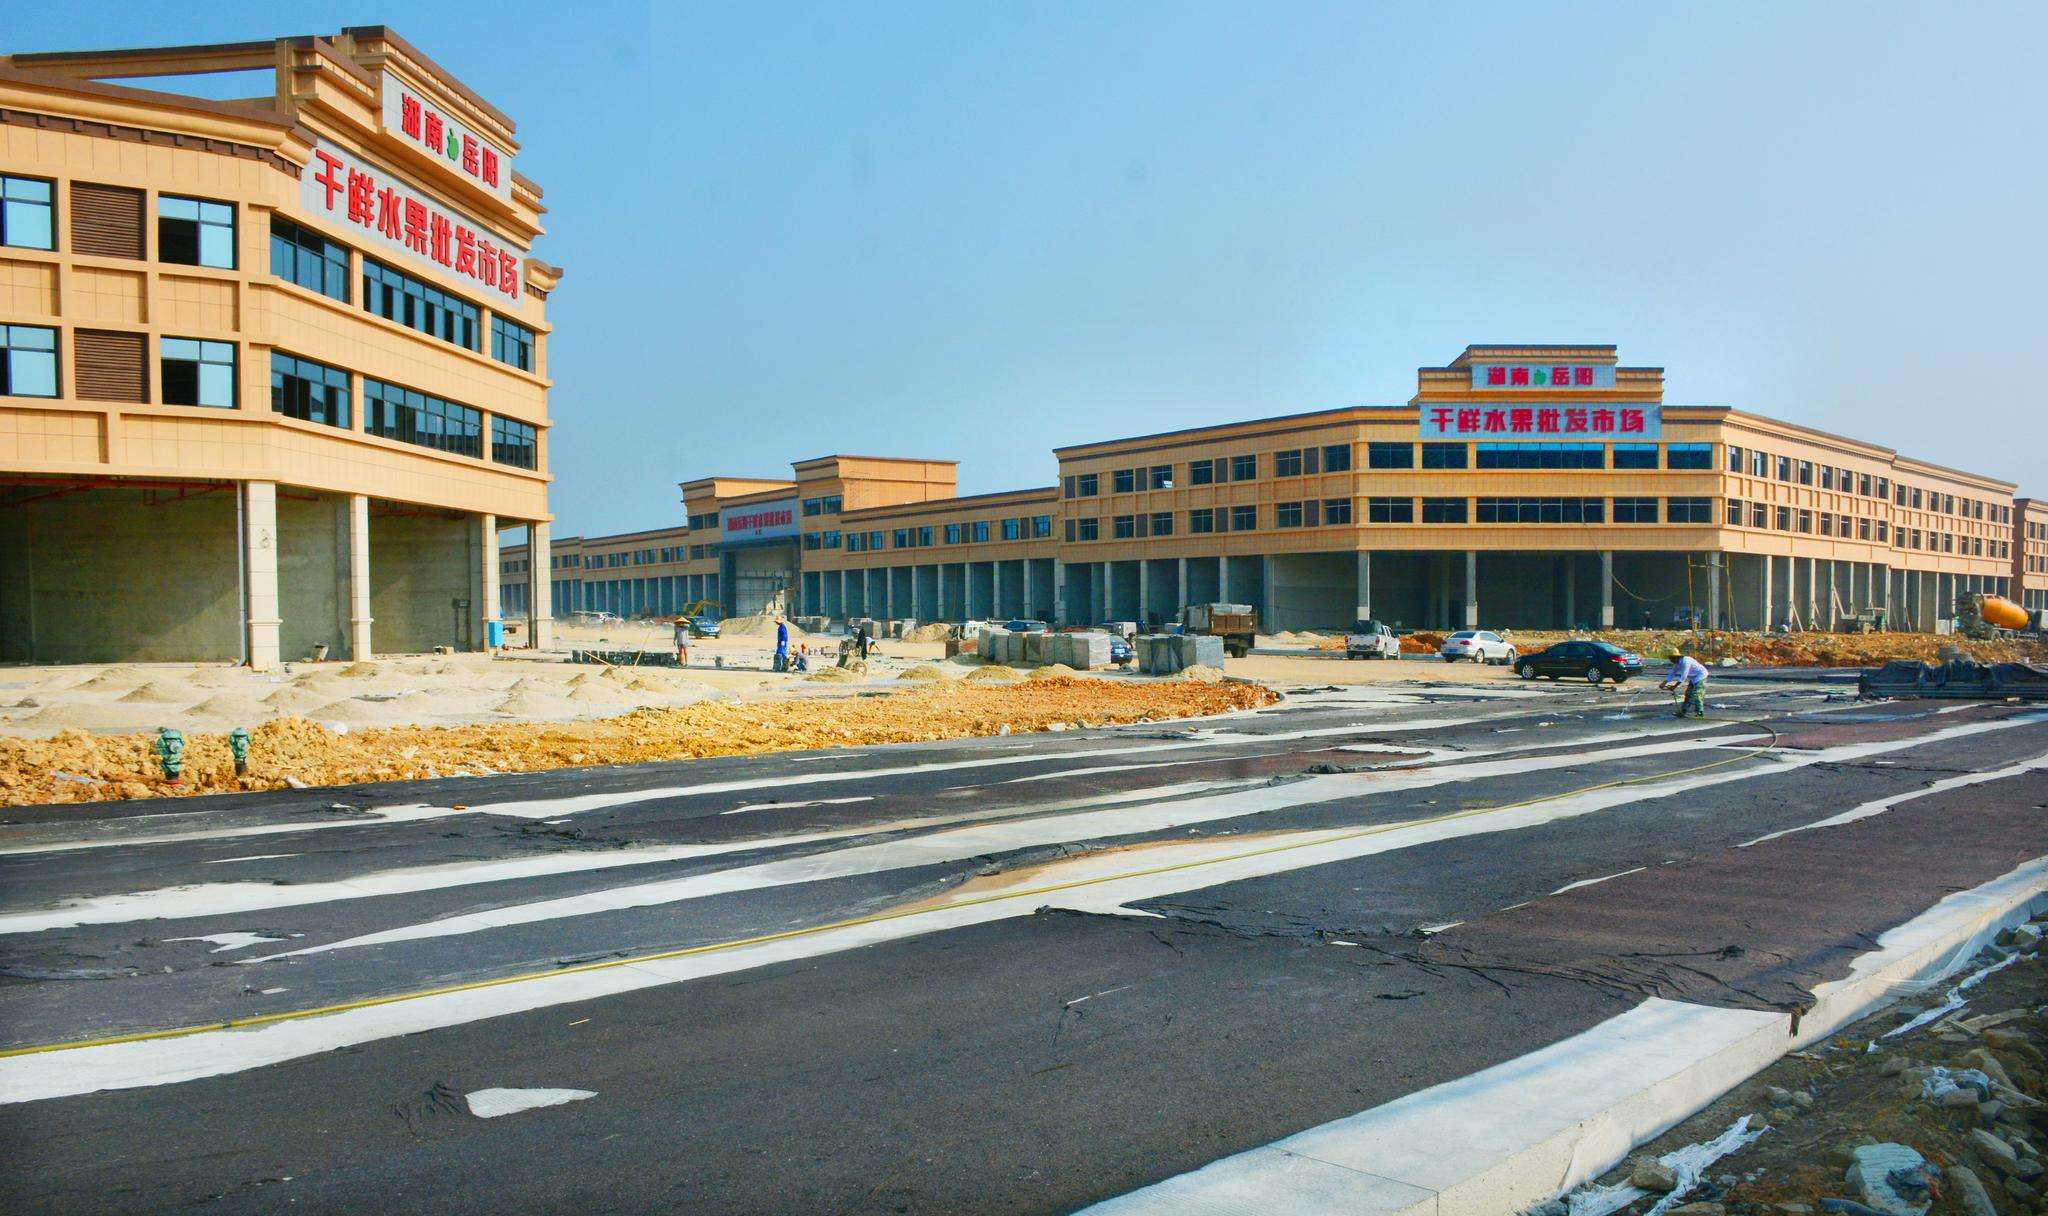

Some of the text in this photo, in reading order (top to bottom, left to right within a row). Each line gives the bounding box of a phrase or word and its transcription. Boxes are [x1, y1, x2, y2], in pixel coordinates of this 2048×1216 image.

[401, 92, 499, 189] 湖南 岳阳
[314, 148, 518, 300] 干鲜水果批发市场
[1487, 366, 1594, 386] 湖南 岳阳
[1430, 407, 1645, 433] 干鲜水果批发市场
